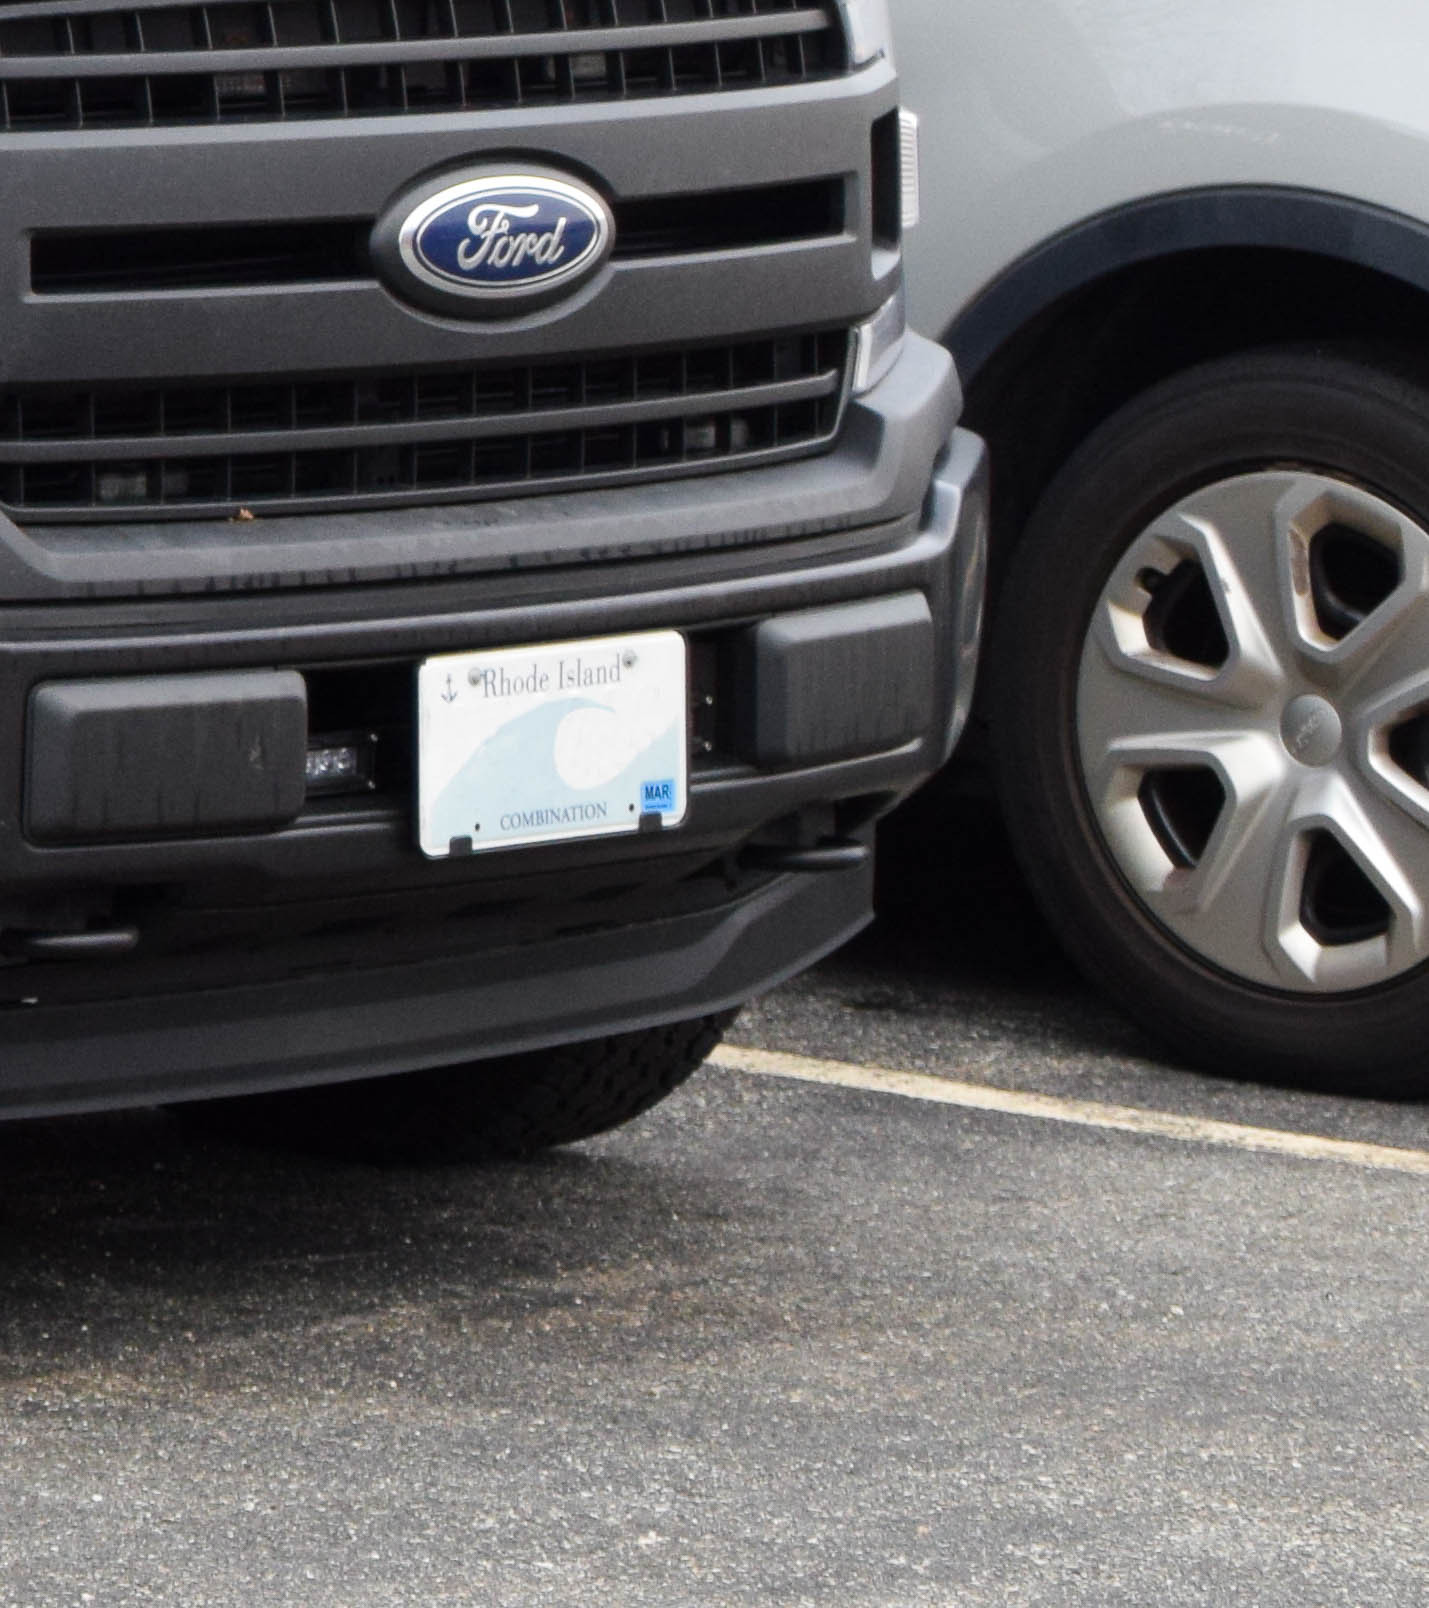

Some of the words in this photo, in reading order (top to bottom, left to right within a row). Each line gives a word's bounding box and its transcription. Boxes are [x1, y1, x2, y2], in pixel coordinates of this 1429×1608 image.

[457, 203, 567, 271] Ford
[483, 664, 549, 698] Rhode
[558, 653, 621, 689] Island
[645, 784, 670, 800] MAR
[500, 802, 607, 832] COMBINATION
